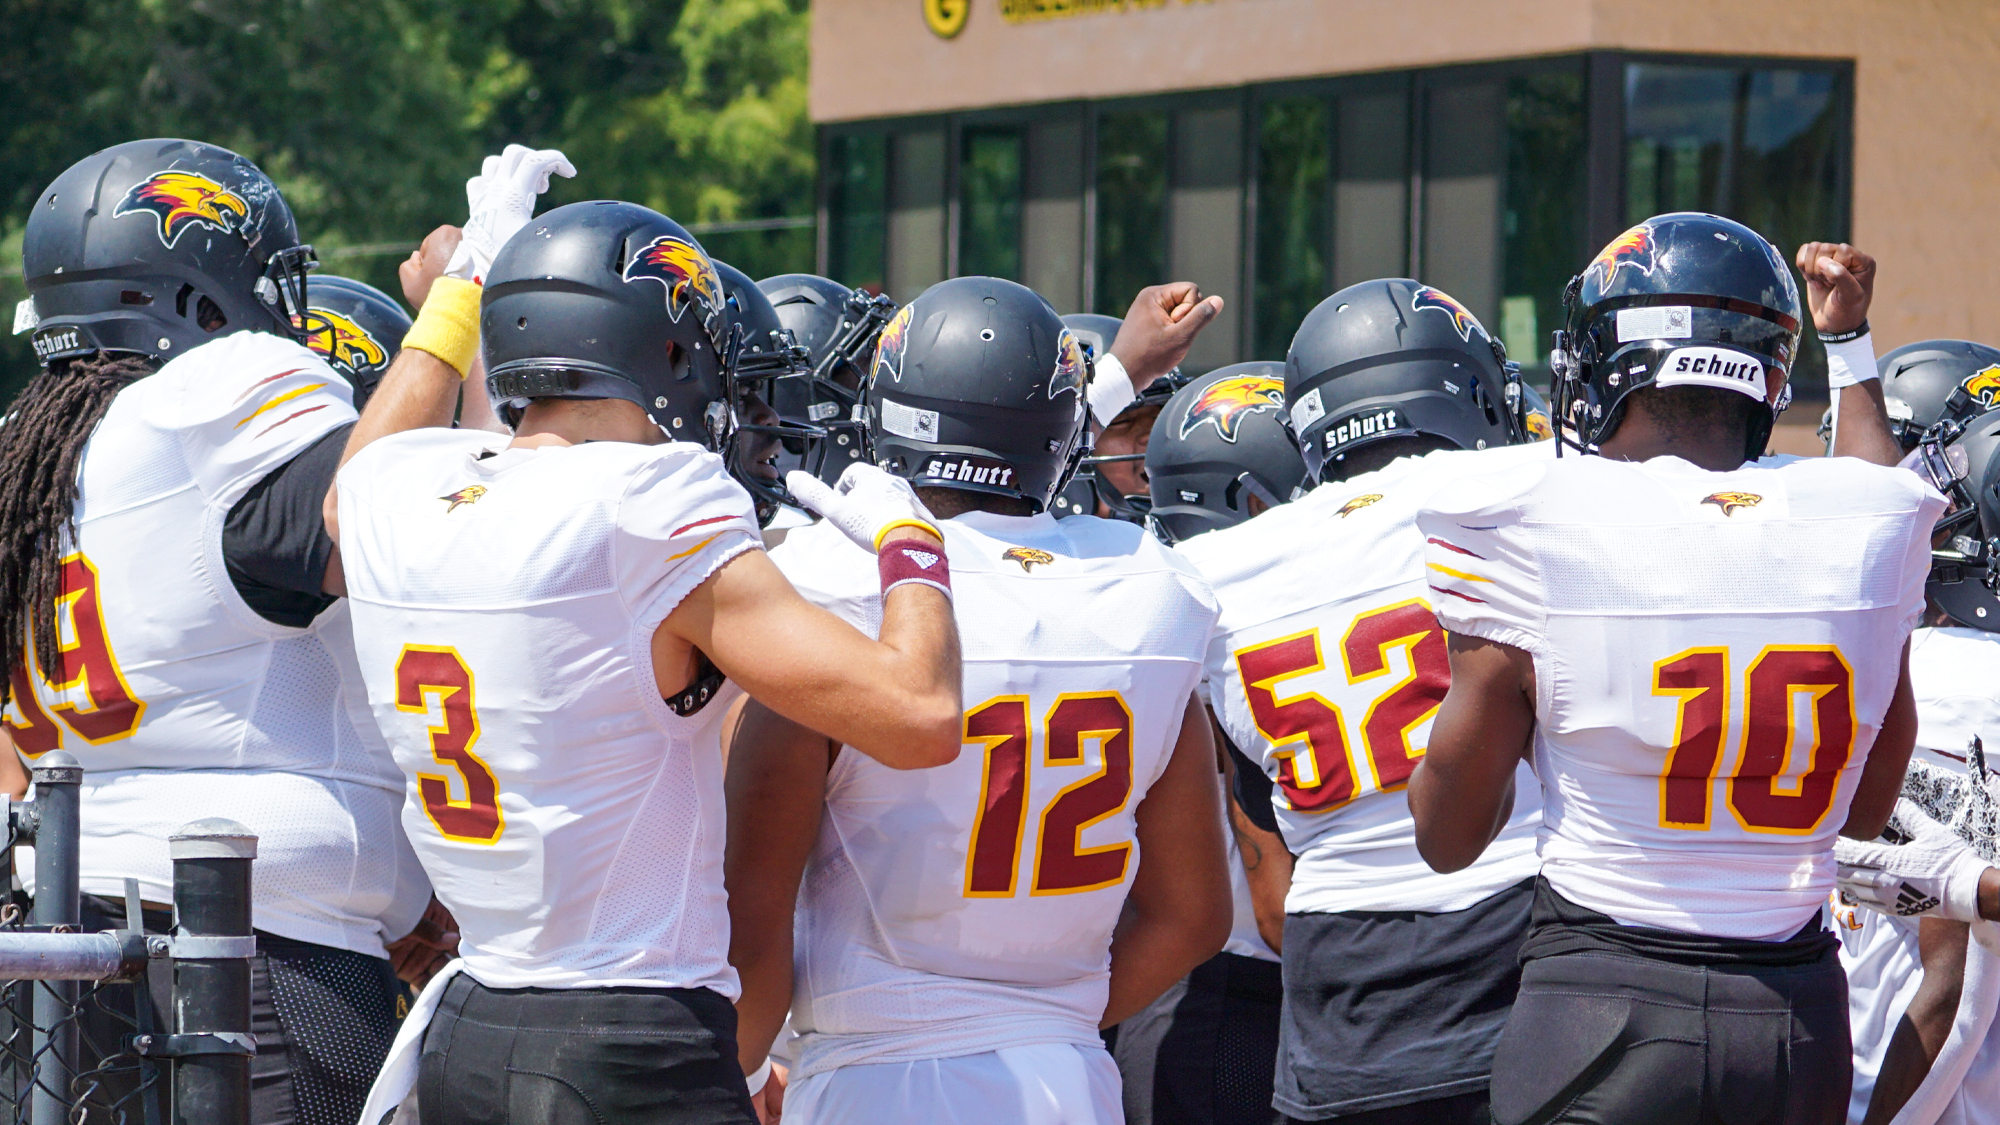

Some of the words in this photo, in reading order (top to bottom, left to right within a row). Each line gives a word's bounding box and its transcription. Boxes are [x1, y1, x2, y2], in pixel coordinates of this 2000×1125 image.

[32, 331, 79, 356] schutt
[1676, 354, 1759, 382] schutt
[1325, 410, 1396, 449] schutt
[926, 459, 1013, 486] schutt
[1233, 597, 1452, 815] 52
[394, 642, 506, 846] 3
[1651, 643, 1859, 836] 10
[961, 689, 1135, 899] 12
[1896, 896, 1941, 917] adidas
